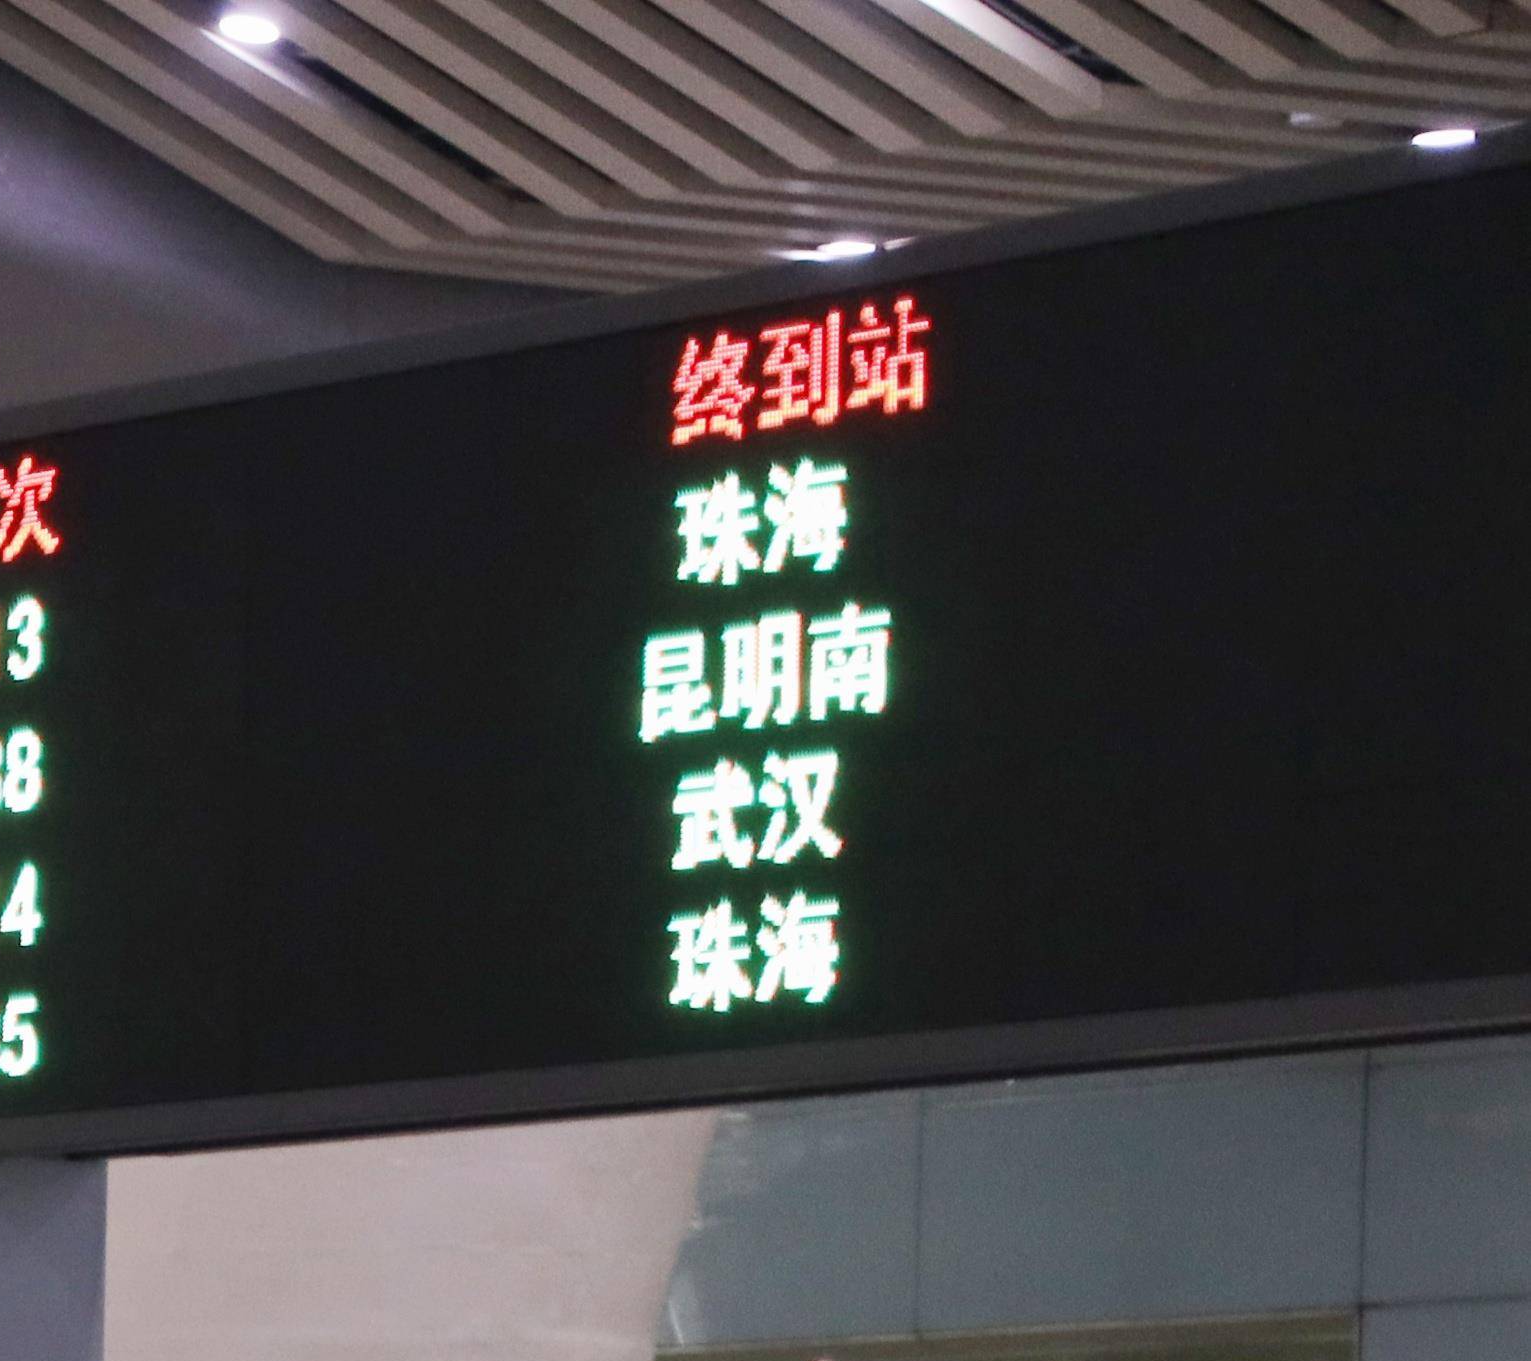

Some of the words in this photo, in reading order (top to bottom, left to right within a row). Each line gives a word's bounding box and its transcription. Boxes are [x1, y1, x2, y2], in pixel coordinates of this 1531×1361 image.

[672, 297, 930, 444] 终到站
[675, 458, 849, 585] 珠海
[639, 602, 892, 743] 昆明南
[672, 750, 845, 871] 武汉
[667, 890, 841, 1013] 珠海
